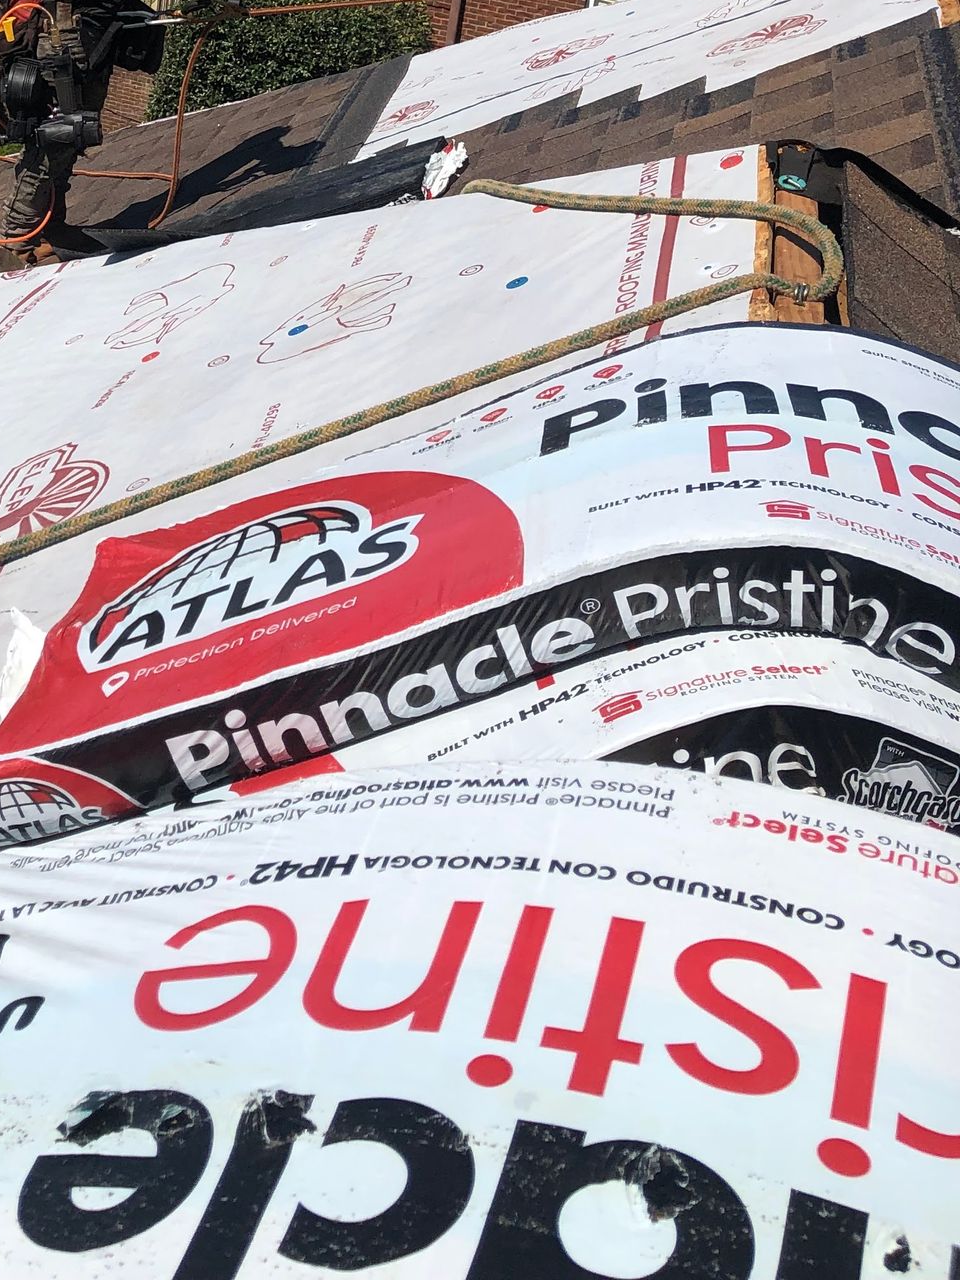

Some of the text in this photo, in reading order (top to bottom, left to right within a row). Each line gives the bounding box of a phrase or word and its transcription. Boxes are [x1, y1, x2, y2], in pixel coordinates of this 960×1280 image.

[615, 251, 645, 315] ROOFING
[588, 497, 631, 513] BUILT
[635, 486, 680, 501] WITH
[769, 479, 891, 510] TECHNOLOGY
[850, 526, 915, 551] ROOFING
[97, 520, 411, 664] ATLAS
[613, 566, 956, 675] Pristine
[134, 596, 358, 682] Protection Delivered
[680, 673, 799, 697] ROOFING SYSTEM
[426, 736, 470, 762] BUILT
[472, 718, 515, 741] WITH
[594, 639, 708, 685] TECHNOLOGY
[857, 679, 911, 704] Please
[912, 697, 943, 716] visit
[886, 745, 906, 758] WITH
[535, 776, 582, 790] visit
[590, 778, 676, 802] Please
[314, 802, 339, 817] the
[352, 797, 376, 812] of
[380, 792, 429, 809] part
[433, 792, 451, 806] is
[456, 791, 540, 807] Pristine
[781, 810, 865, 840] SYSTEM
[363, 854, 542, 873] TECNOLOGÍA
[548, 858, 618, 881] CON
[98, 873, 218, 908] CONSTRUIT
[626, 870, 846, 931] CONSTRUIDO
[12, 901, 40, 919] LA
[39, 895, 97, 913] AVEC
